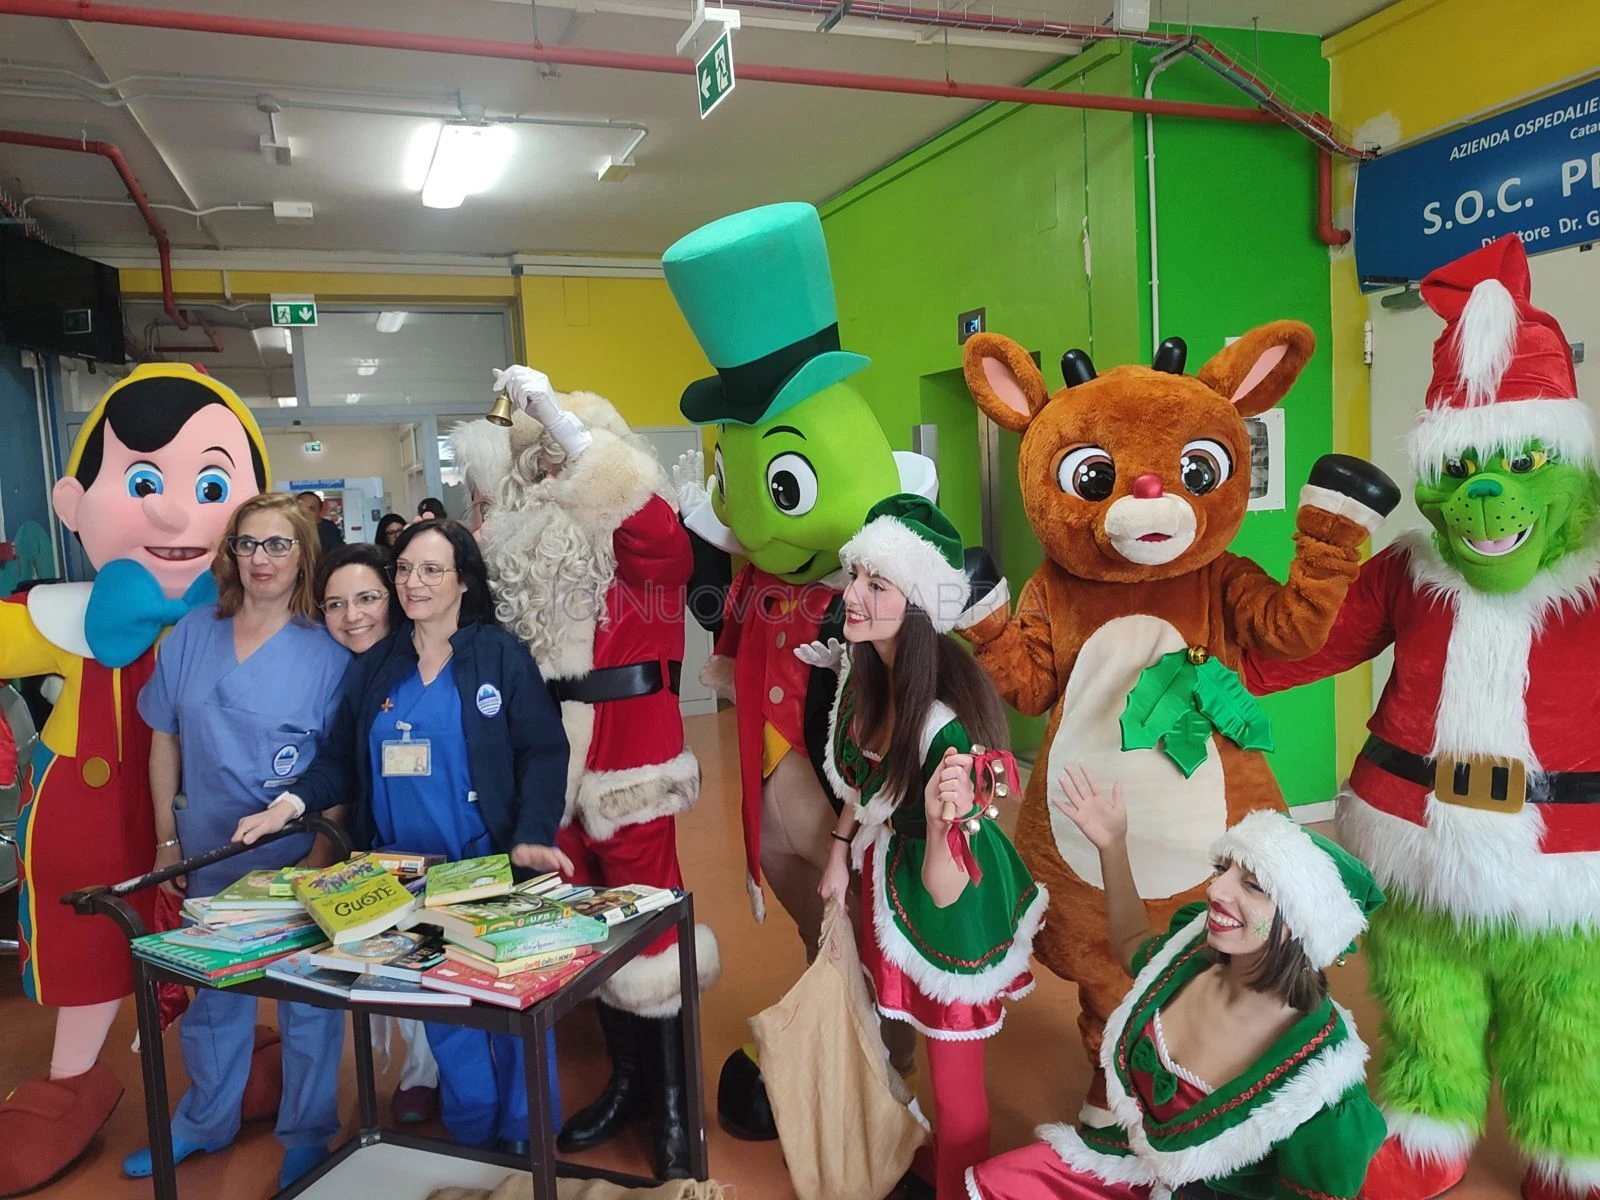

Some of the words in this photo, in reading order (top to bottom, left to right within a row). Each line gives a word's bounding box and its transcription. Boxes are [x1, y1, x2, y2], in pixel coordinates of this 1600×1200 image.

[1449, 128, 1510, 161] AZIENDA
[1514, 96, 1600, 139] OSPEDALIE
[1423, 177, 1534, 235] S.O.C.
[1558, 217, 1583, 234] Dr.
